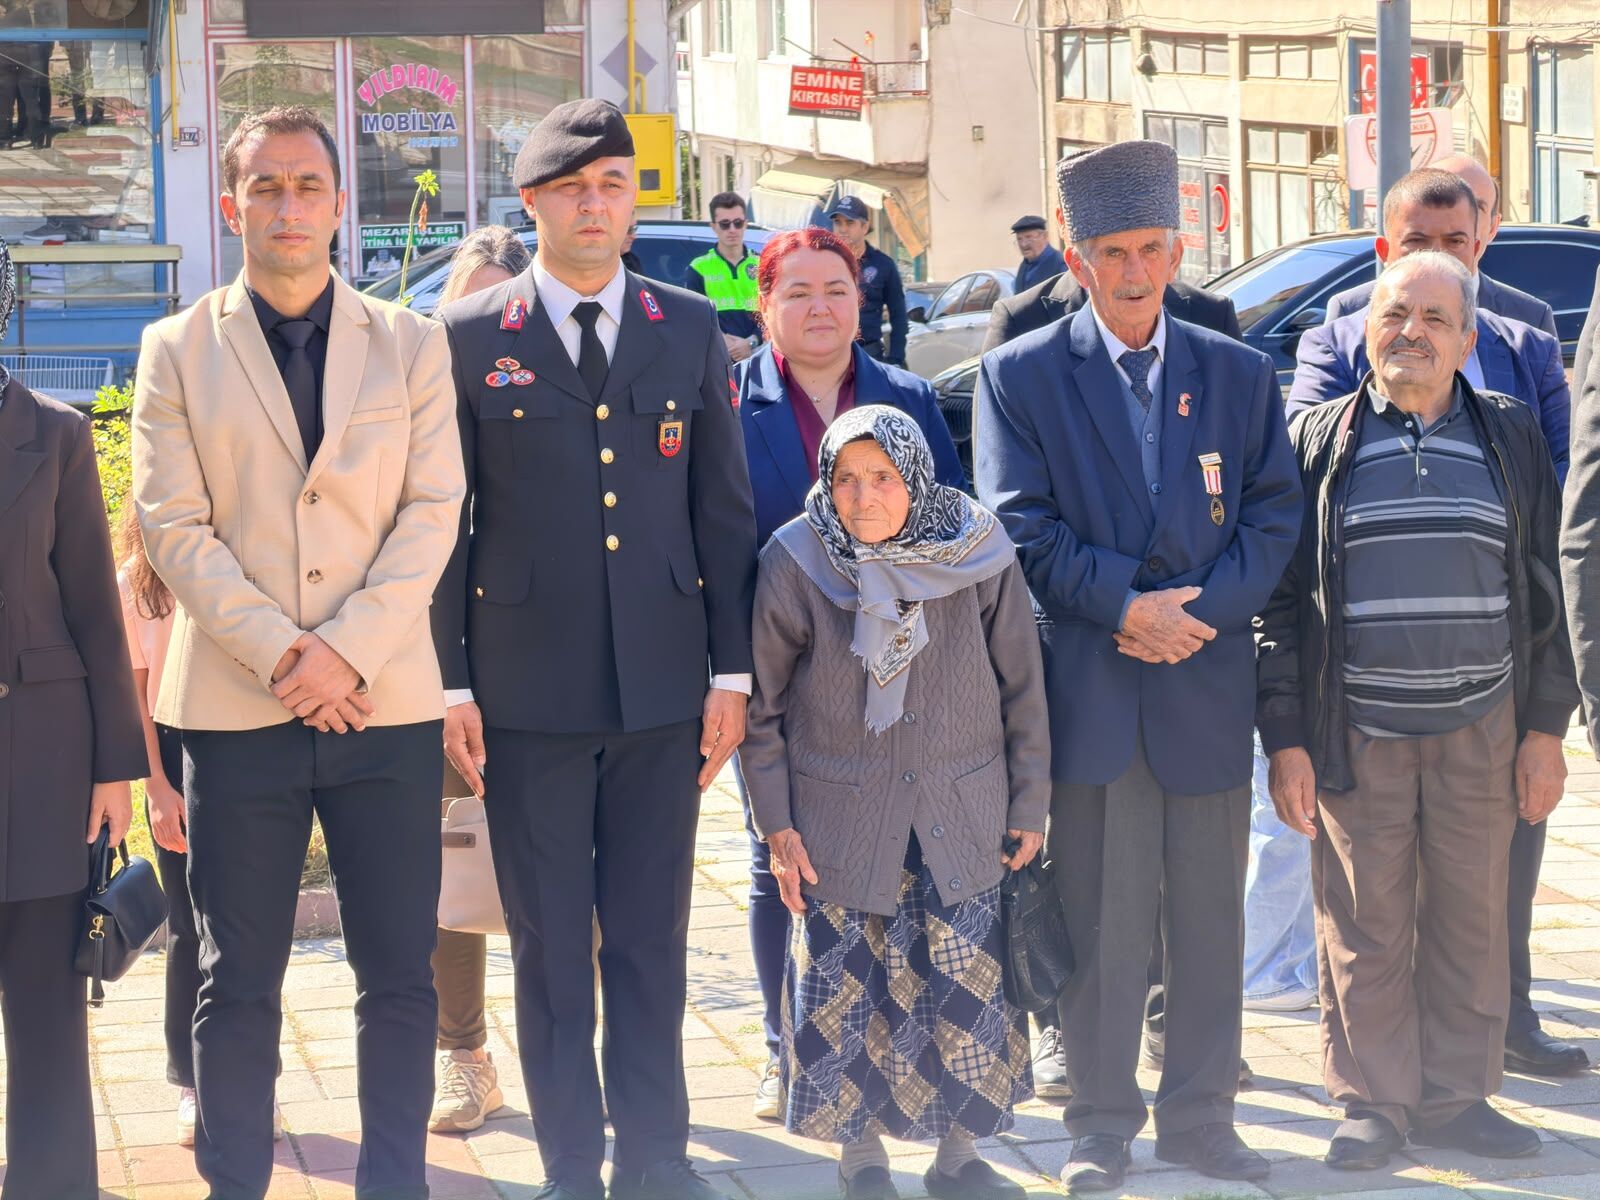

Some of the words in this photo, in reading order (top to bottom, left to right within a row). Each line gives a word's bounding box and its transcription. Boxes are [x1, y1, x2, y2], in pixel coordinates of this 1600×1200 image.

[357, 63, 458, 107] YILDIRIM
[793, 71, 862, 91] EMİNE
[791, 89, 861, 108] KIRTASİYE
[362, 108, 457, 133] MOBİLYA
[362, 227, 409, 237] MEZAR
[362, 237, 393, 247] İTİNA
